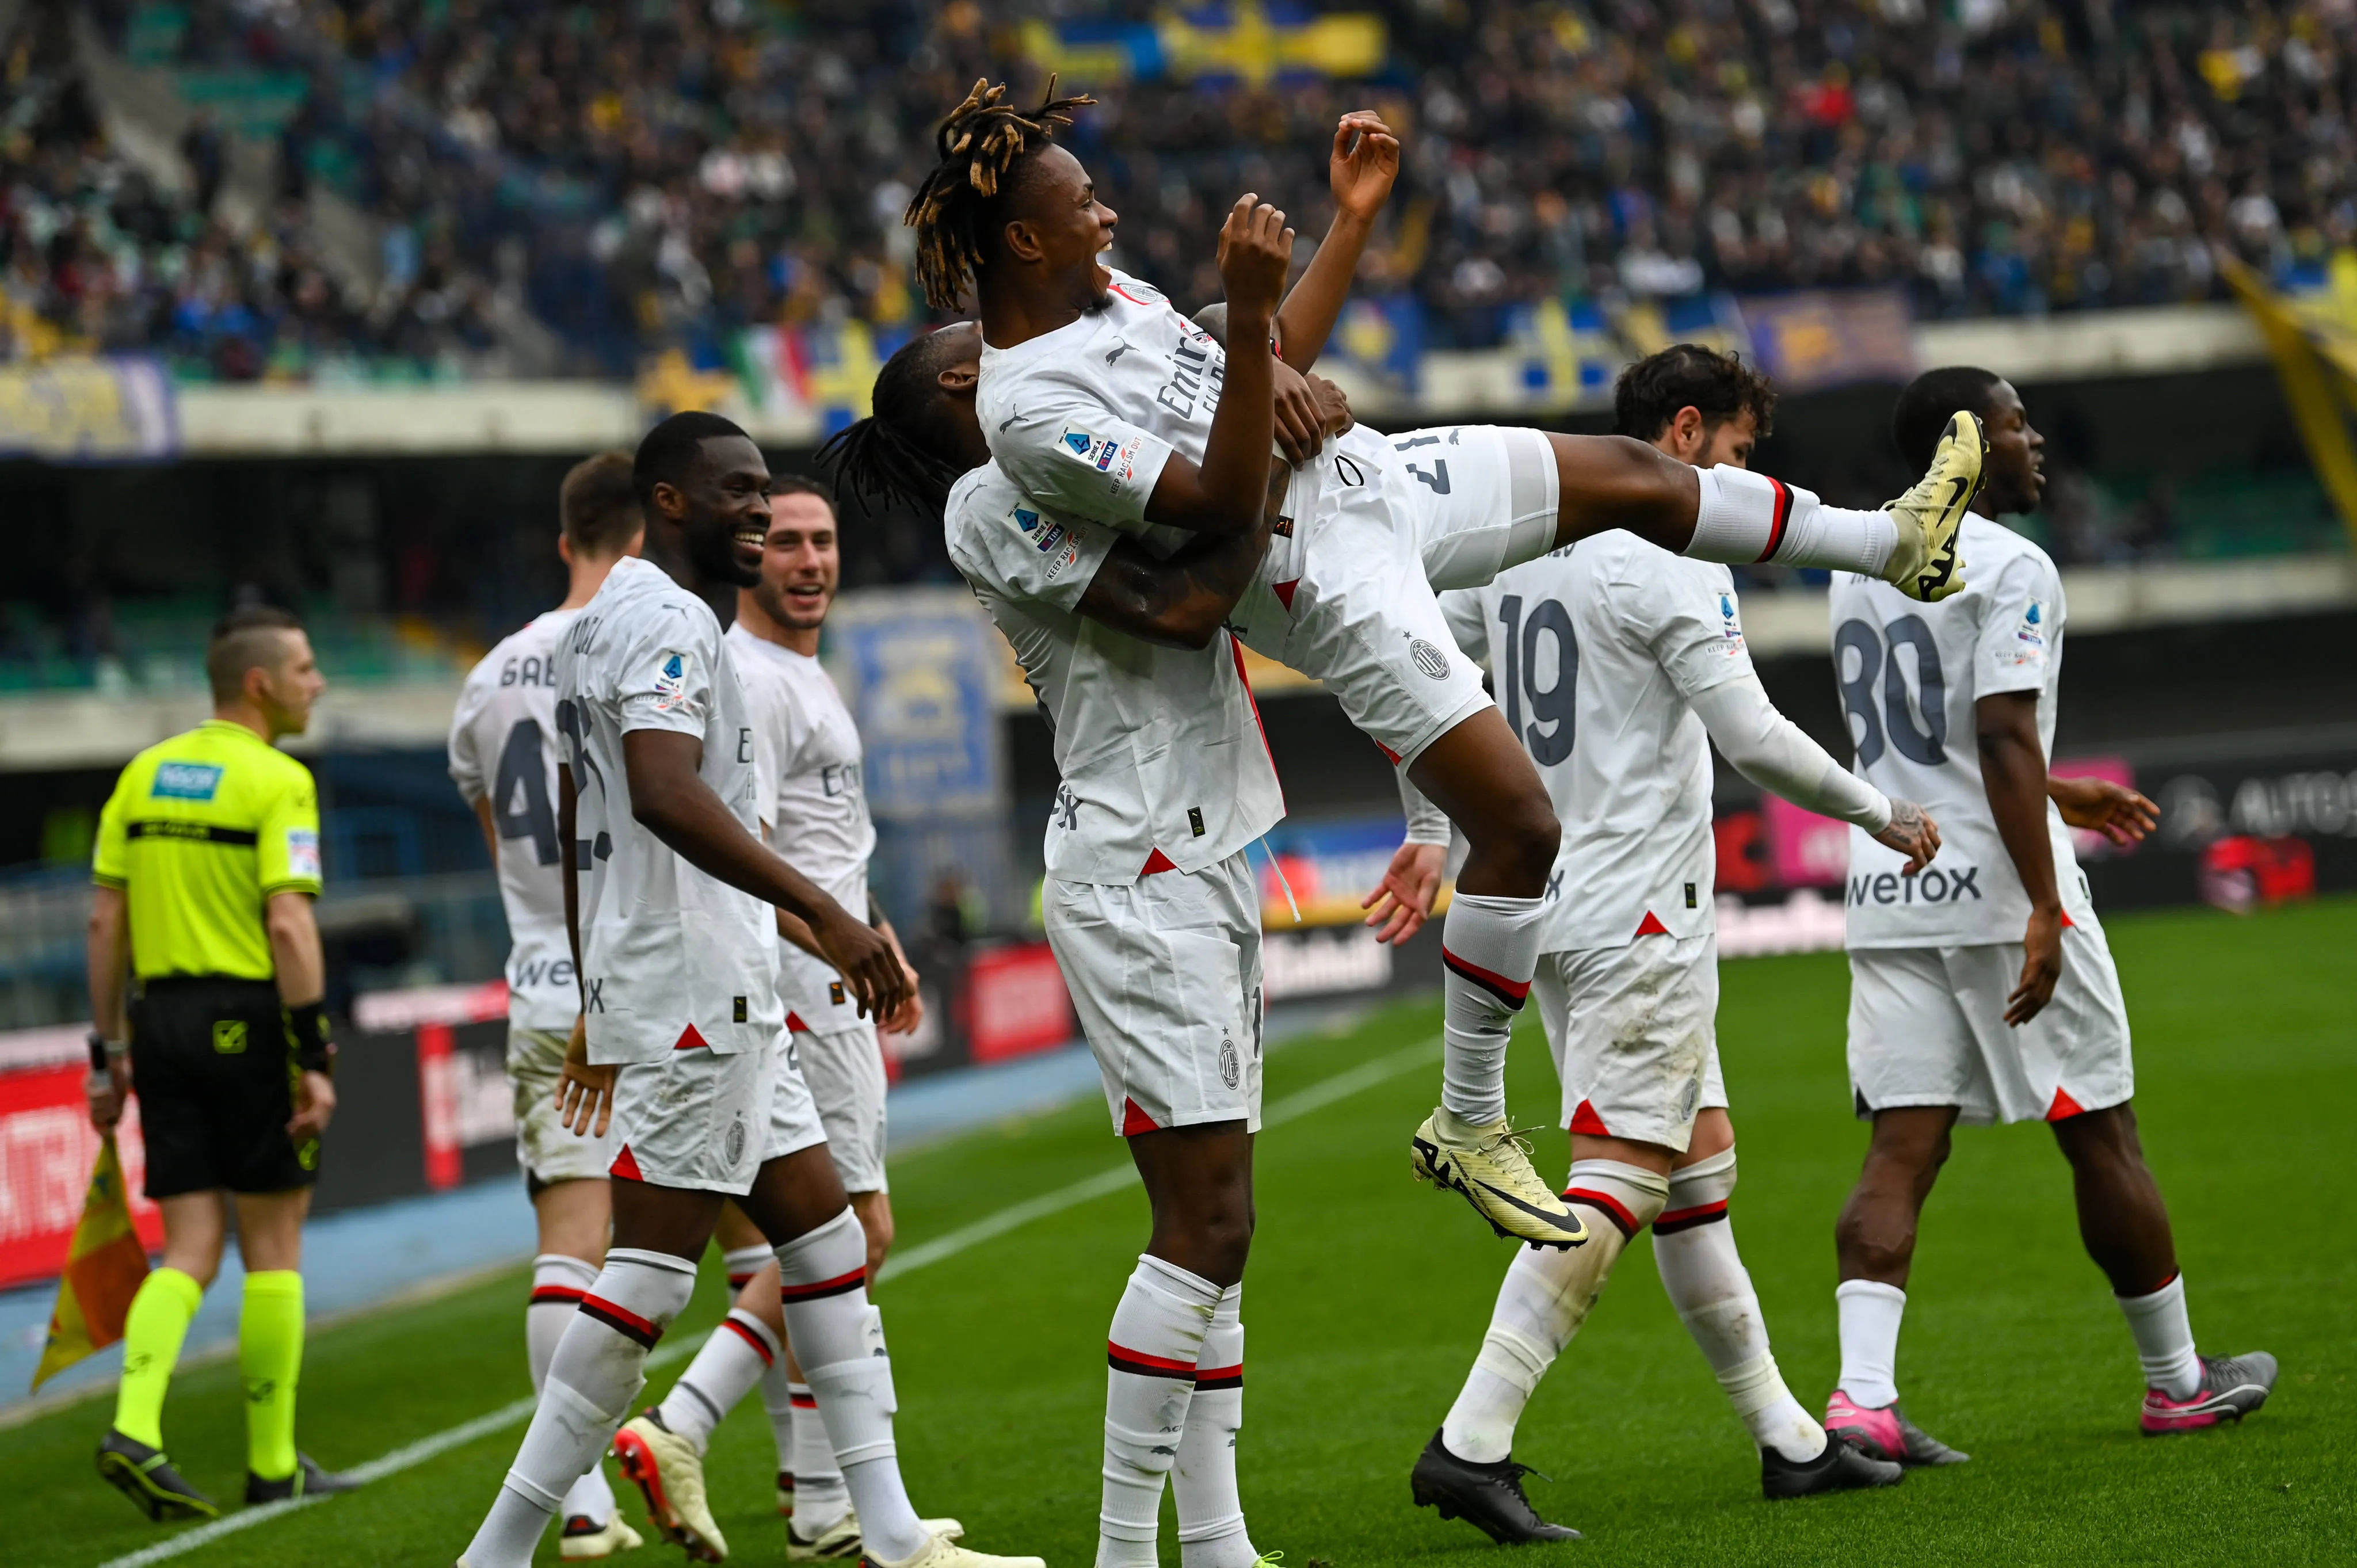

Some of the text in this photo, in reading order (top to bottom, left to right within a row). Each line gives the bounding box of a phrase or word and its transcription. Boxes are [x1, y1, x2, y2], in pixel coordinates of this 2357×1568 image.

[1088, 444, 1100, 461] SERIE
[1103, 445, 1115, 459] TIM
[1110, 437, 1142, 495] KEEP RACISM OUT
[1031, 524, 1046, 541] SERIE
[1047, 528, 1062, 541] TIM
[1047, 560, 1062, 579] KEEP
[1060, 535, 1081, 561] RACISM
[1435, 666, 1447, 677] 1899
[1499, 594, 1579, 766] 19
[1835, 613, 1948, 772] 80
[494, 719, 560, 865] 4
